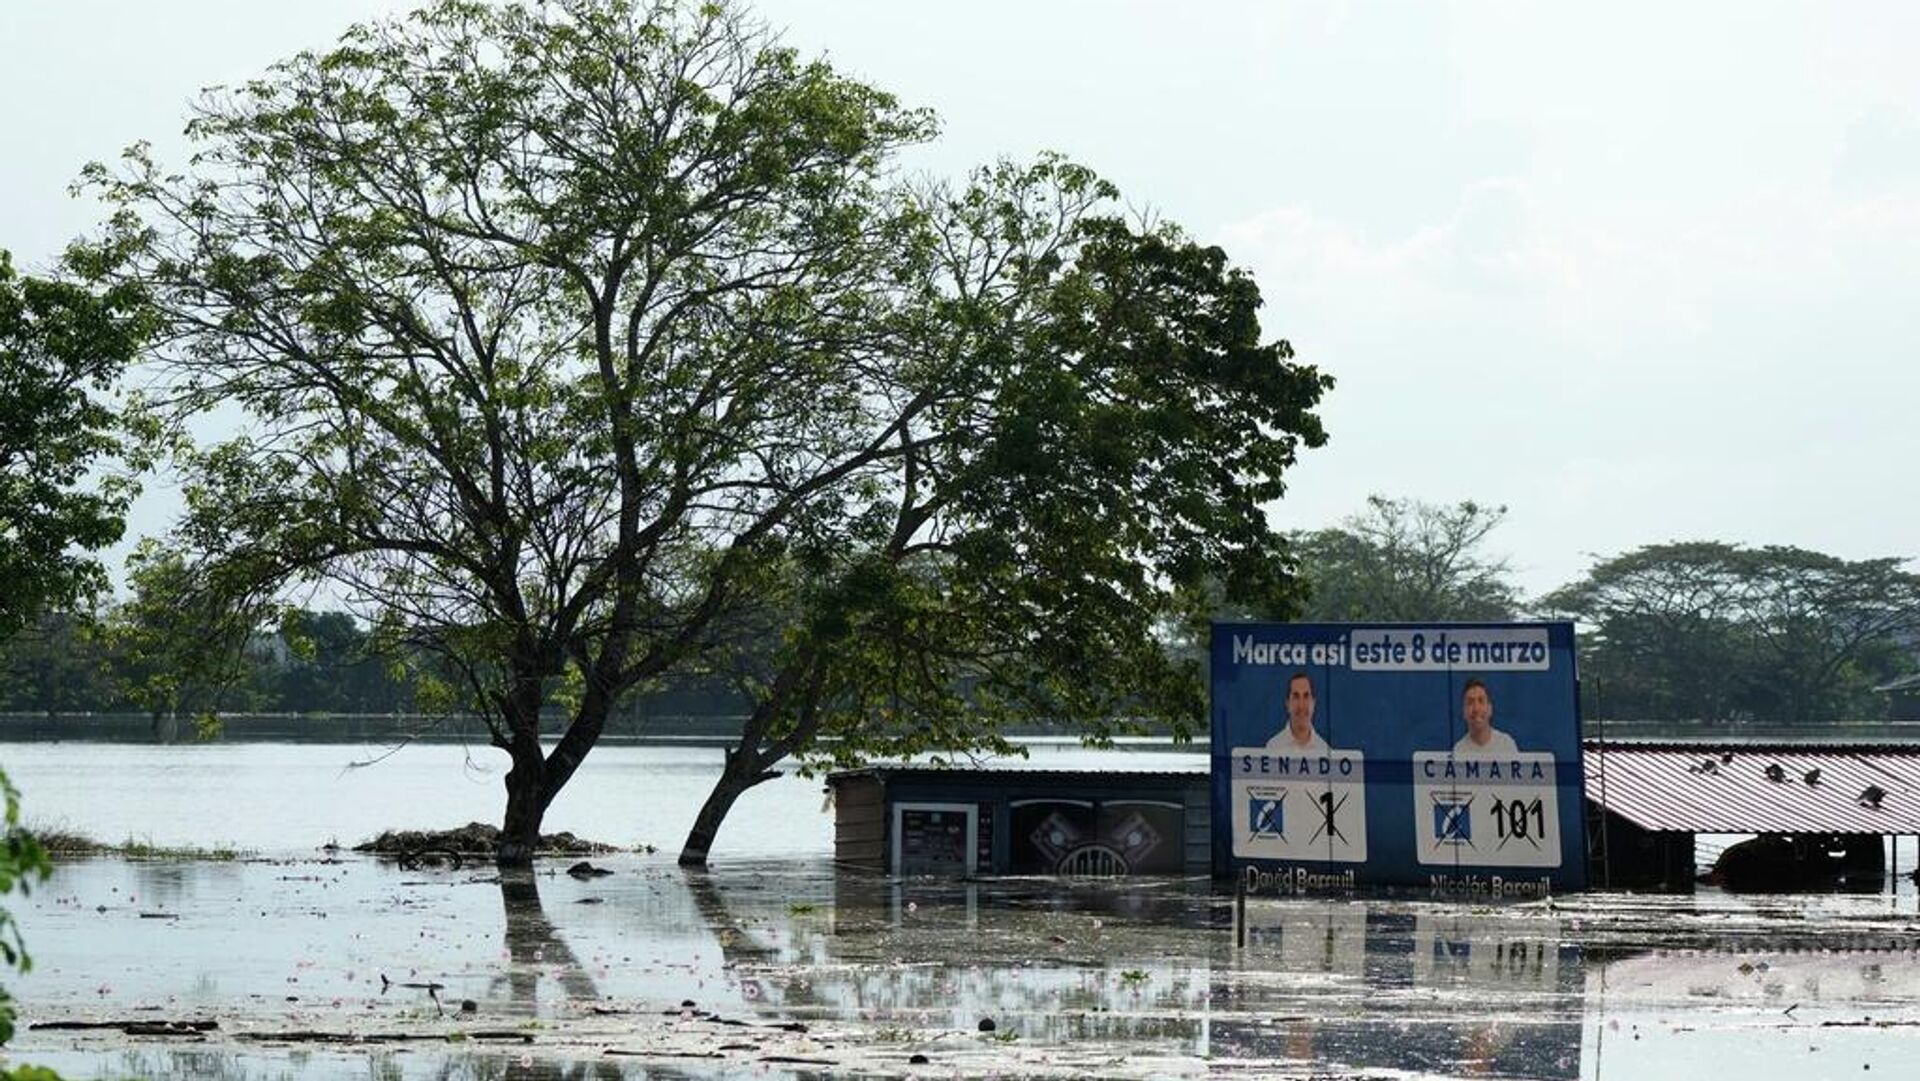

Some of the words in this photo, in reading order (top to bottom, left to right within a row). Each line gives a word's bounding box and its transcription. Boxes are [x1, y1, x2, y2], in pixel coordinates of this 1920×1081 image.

[1232, 634, 1306, 666] Marca
[1312, 635, 1347, 666] así
[1355, 637, 1406, 664] este
[1411, 633, 1425, 663] 8
[1430, 633, 1461, 664] de
[1467, 639, 1546, 664] marzo
[1242, 755, 1352, 776] SENADO
[1424, 753, 1545, 779] CÁMARA
[1319, 791, 1335, 836] 1
[1490, 799, 1545, 839] 101
[1245, 864, 1293, 889] David
